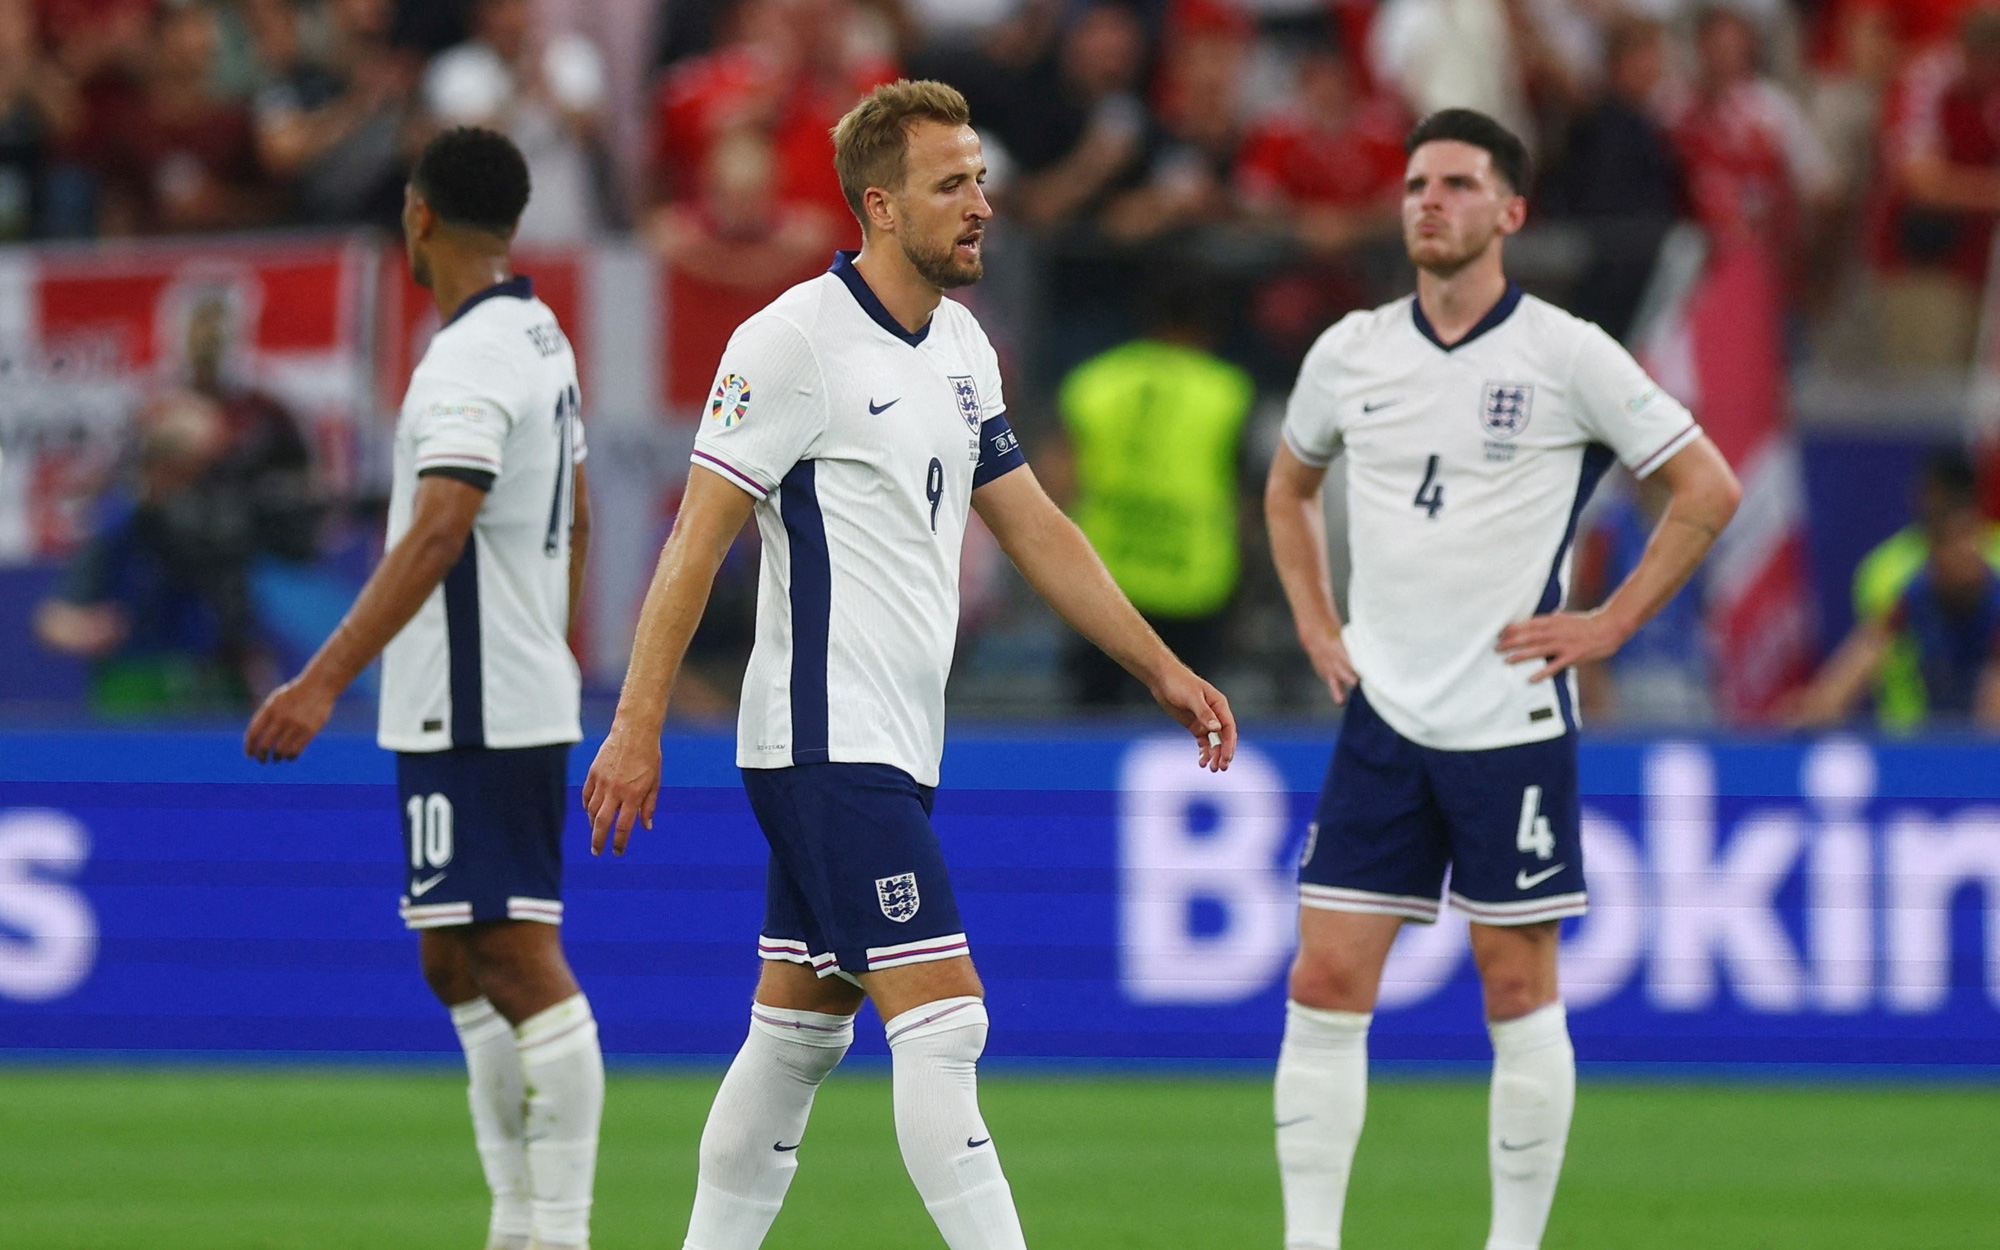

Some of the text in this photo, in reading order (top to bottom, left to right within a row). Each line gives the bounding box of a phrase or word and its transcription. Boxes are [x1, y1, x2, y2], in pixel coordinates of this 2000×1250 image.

[926, 456, 944, 535] 9
[1414, 454, 1444, 519] 4
[407, 792, 454, 868] 10
[1516, 785, 1556, 860] 4
